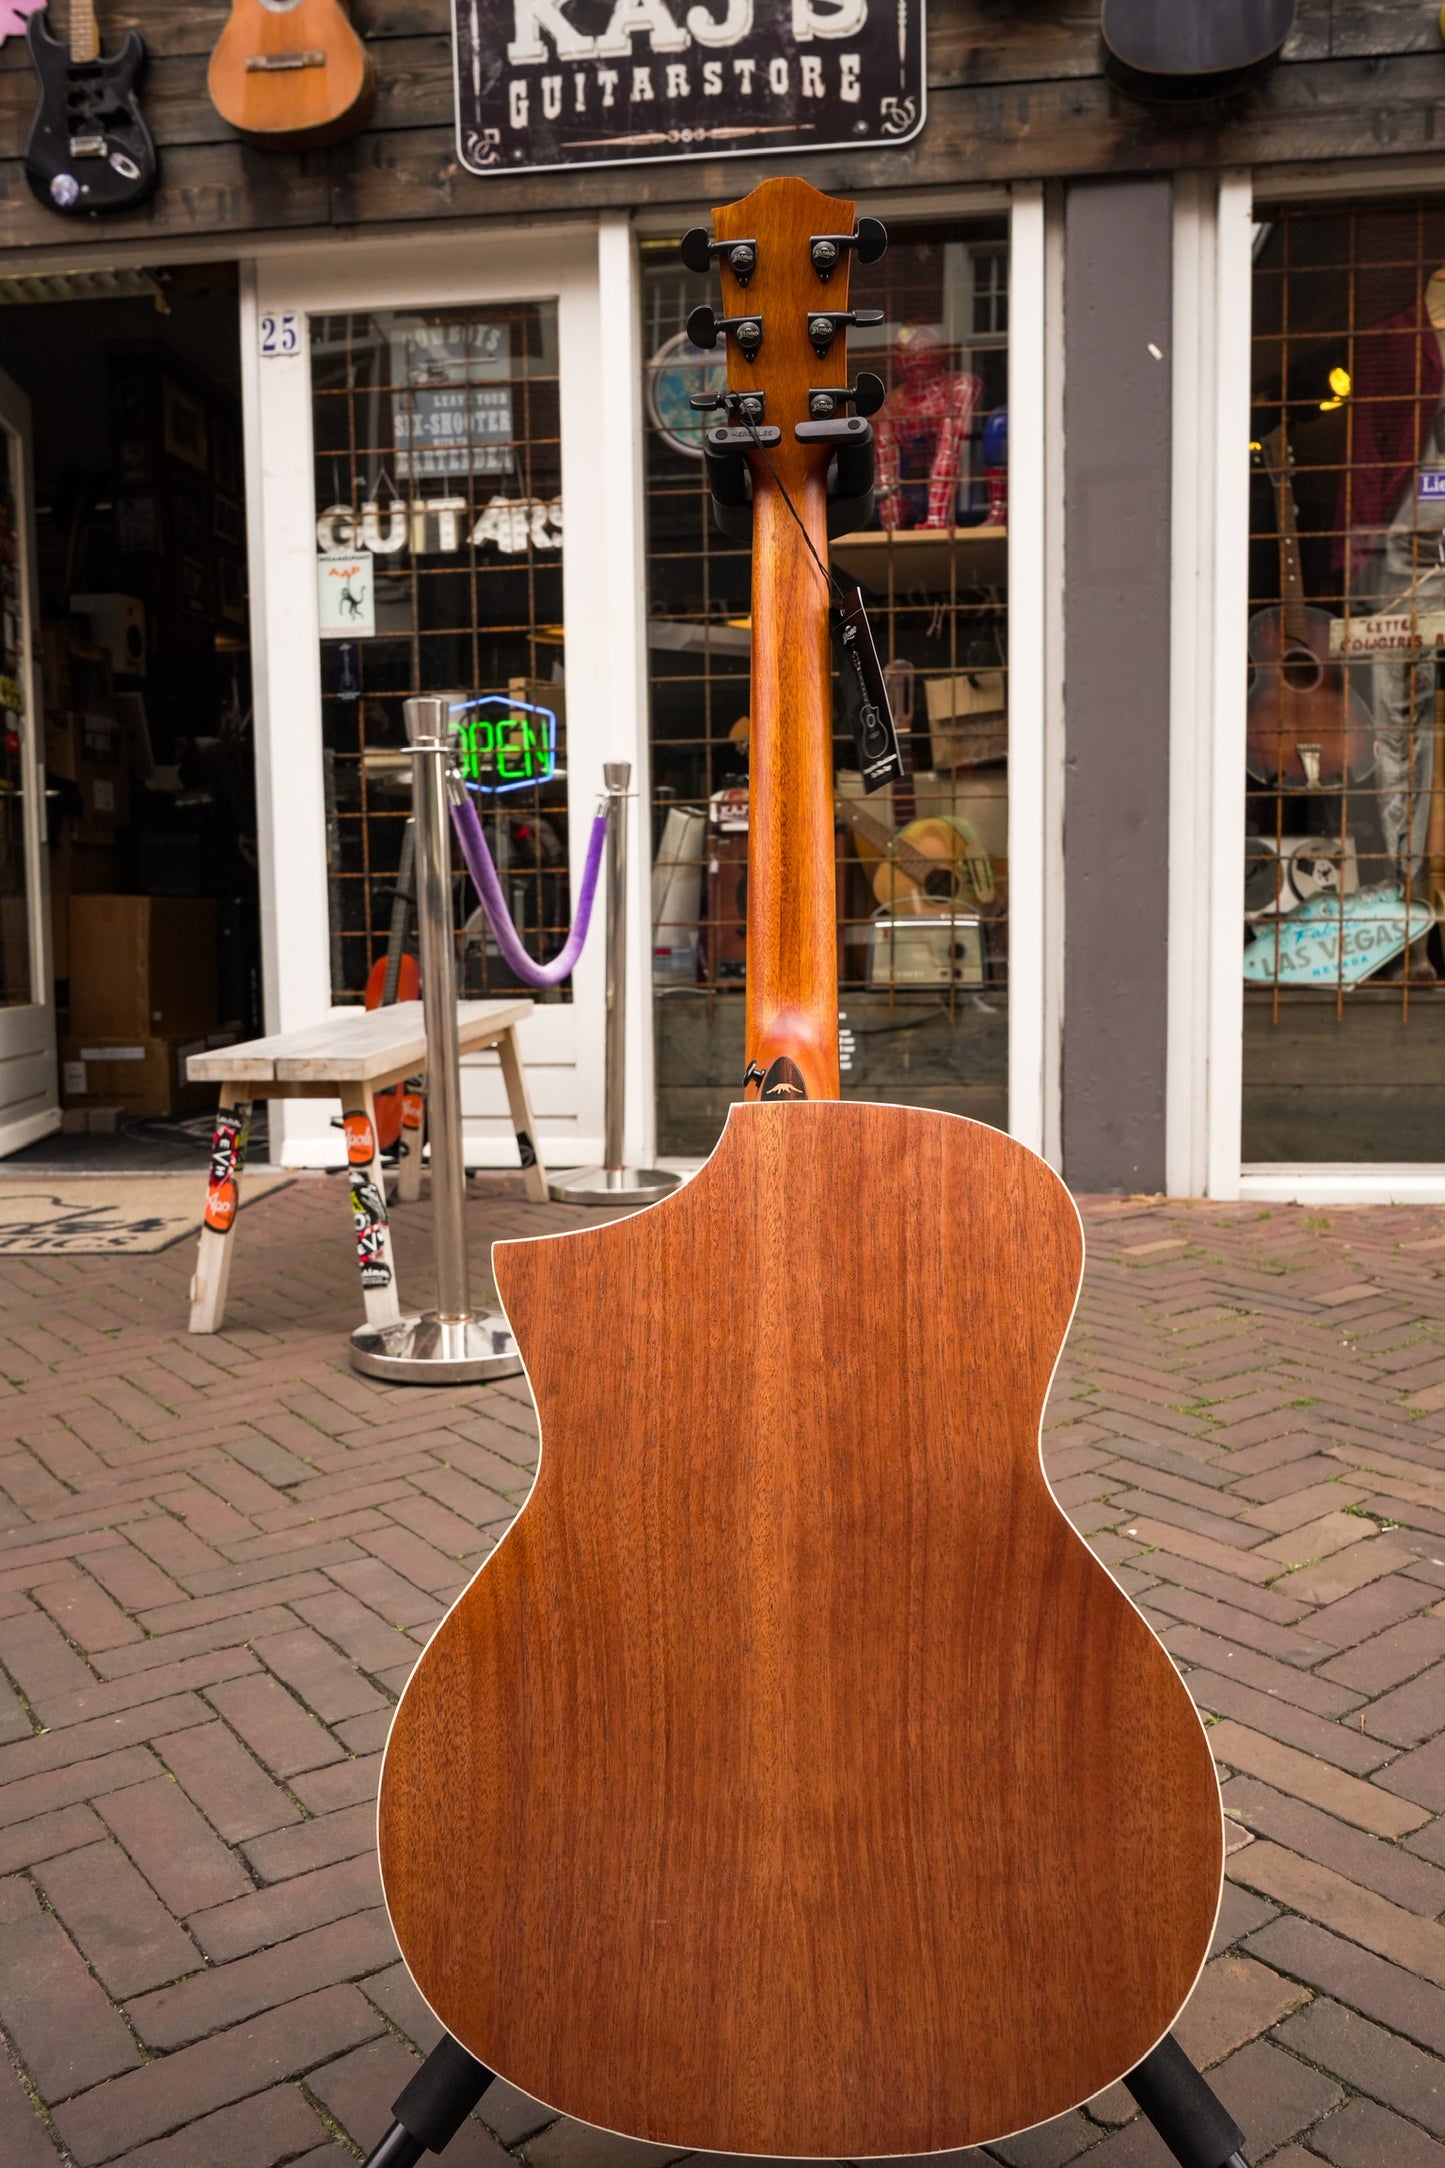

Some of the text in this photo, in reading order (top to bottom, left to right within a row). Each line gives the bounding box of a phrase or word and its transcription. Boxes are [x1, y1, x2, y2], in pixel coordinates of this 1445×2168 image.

[507, 0, 868, 65] KAJS
[508, 54, 861, 129] GUITARSTORE
[261, 316, 297, 351] 25
[408, 324, 502, 351] OWBOYS
[433, 395, 467, 408] LEAV
[395, 410, 512, 437] SIX-SHOOTER
[731, 430, 773, 438] HERLES
[328, 565, 361, 578] AAP
[1261, 921, 1406, 977] LAS VEGAS
